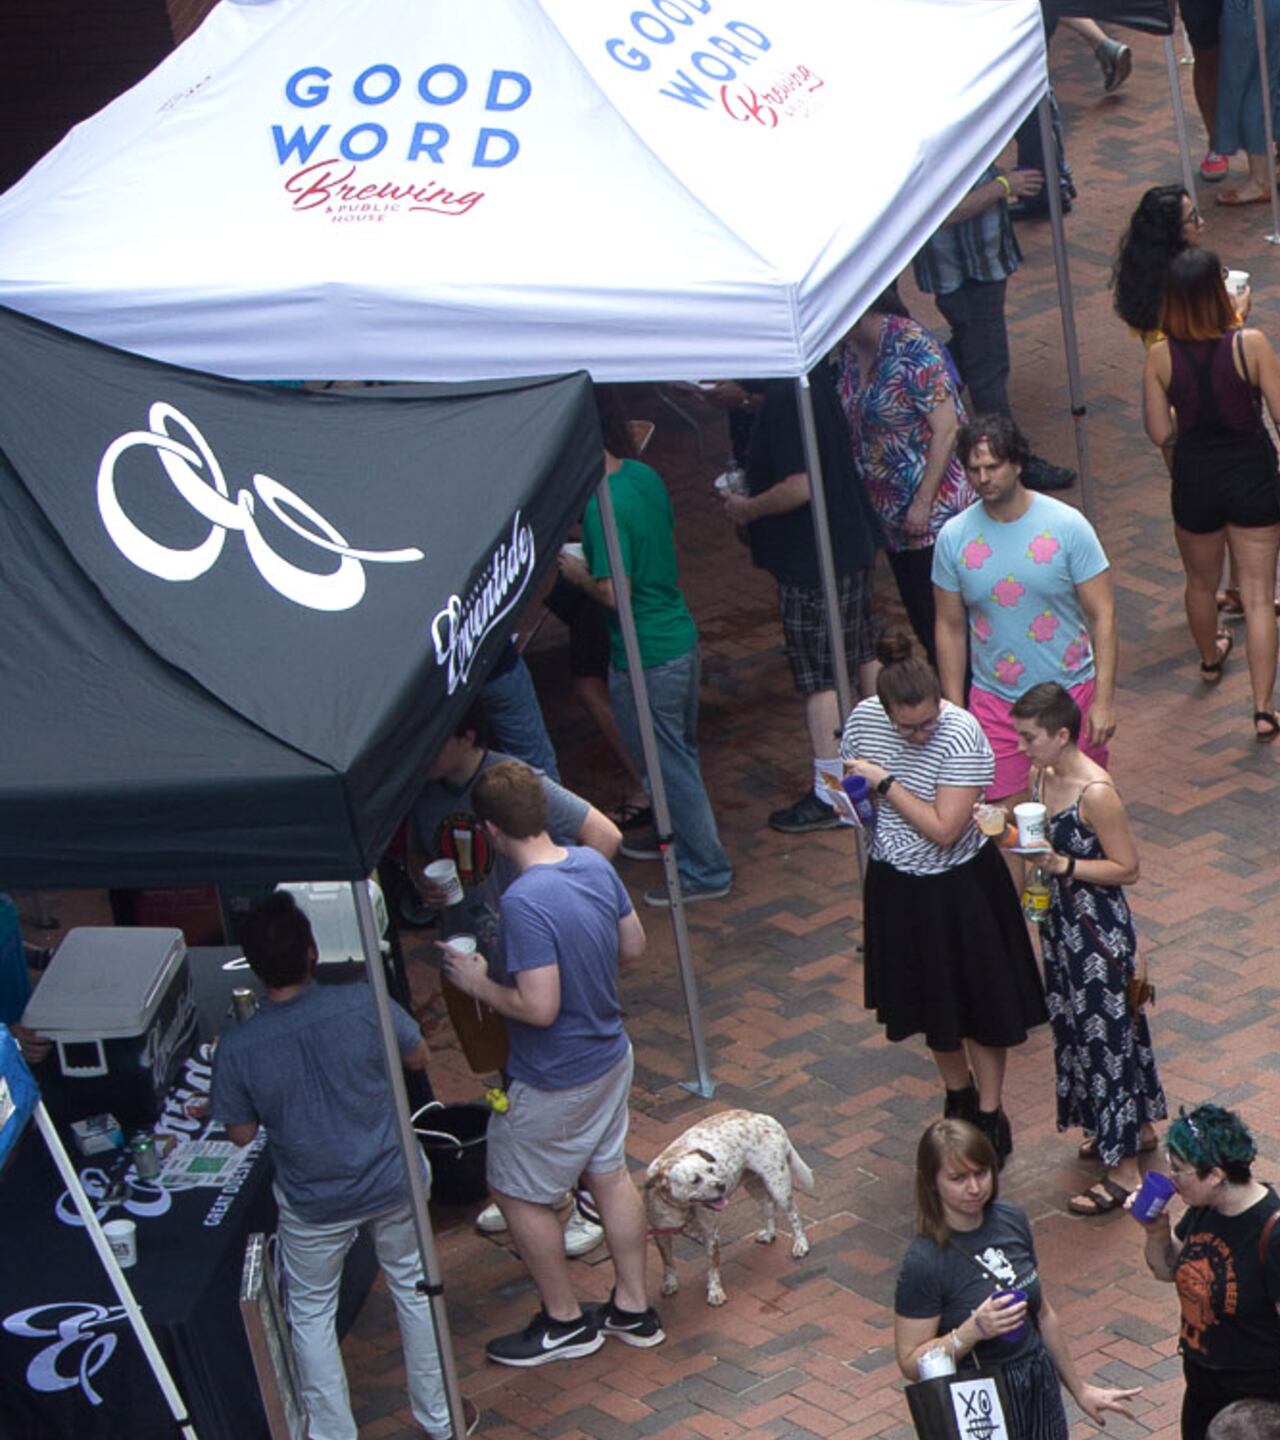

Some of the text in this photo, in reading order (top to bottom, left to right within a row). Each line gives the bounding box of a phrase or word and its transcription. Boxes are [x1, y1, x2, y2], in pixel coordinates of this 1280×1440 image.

[284, 62, 533, 112] GOOD
[658, 19, 772, 112] WORD
[271, 121, 521, 169] WORD
[284, 157, 486, 216] Brewing
